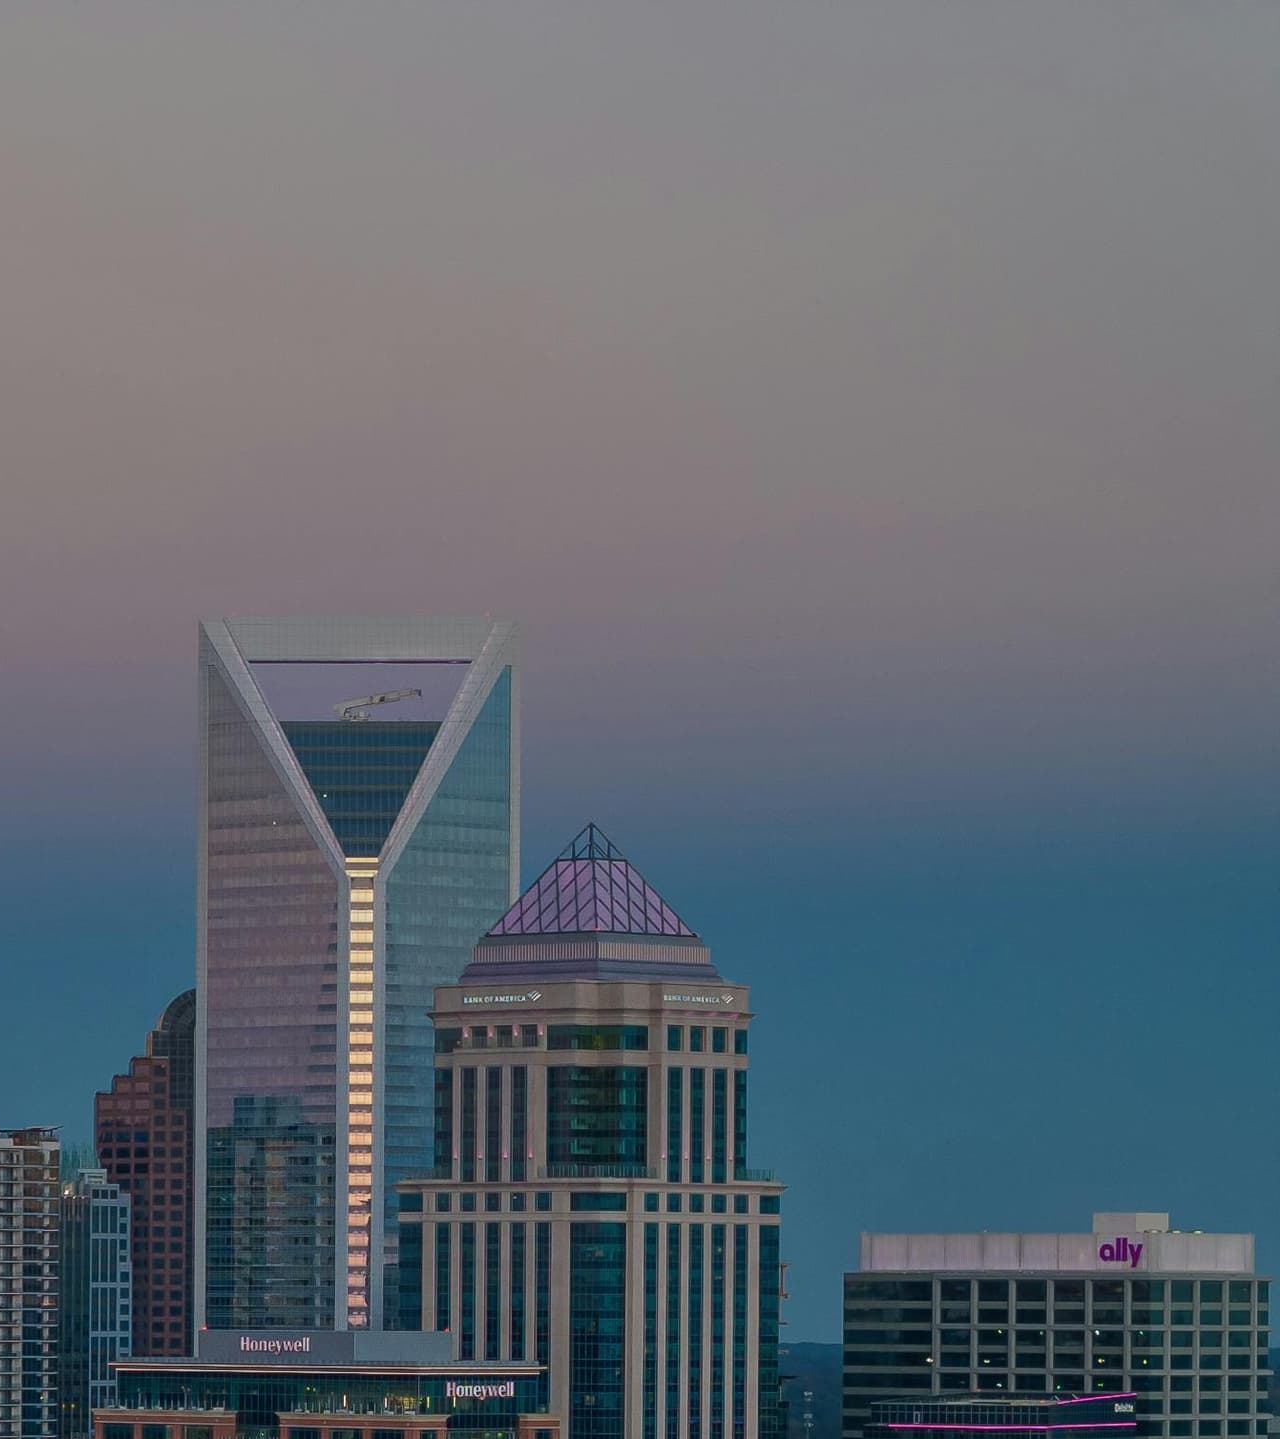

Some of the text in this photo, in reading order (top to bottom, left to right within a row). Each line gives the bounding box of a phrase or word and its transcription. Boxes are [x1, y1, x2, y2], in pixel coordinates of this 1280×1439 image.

[1099, 1237, 1144, 1268] ally
[240, 1336, 311, 1355] Honeywell
[446, 1381, 515, 1400] Honeywell
